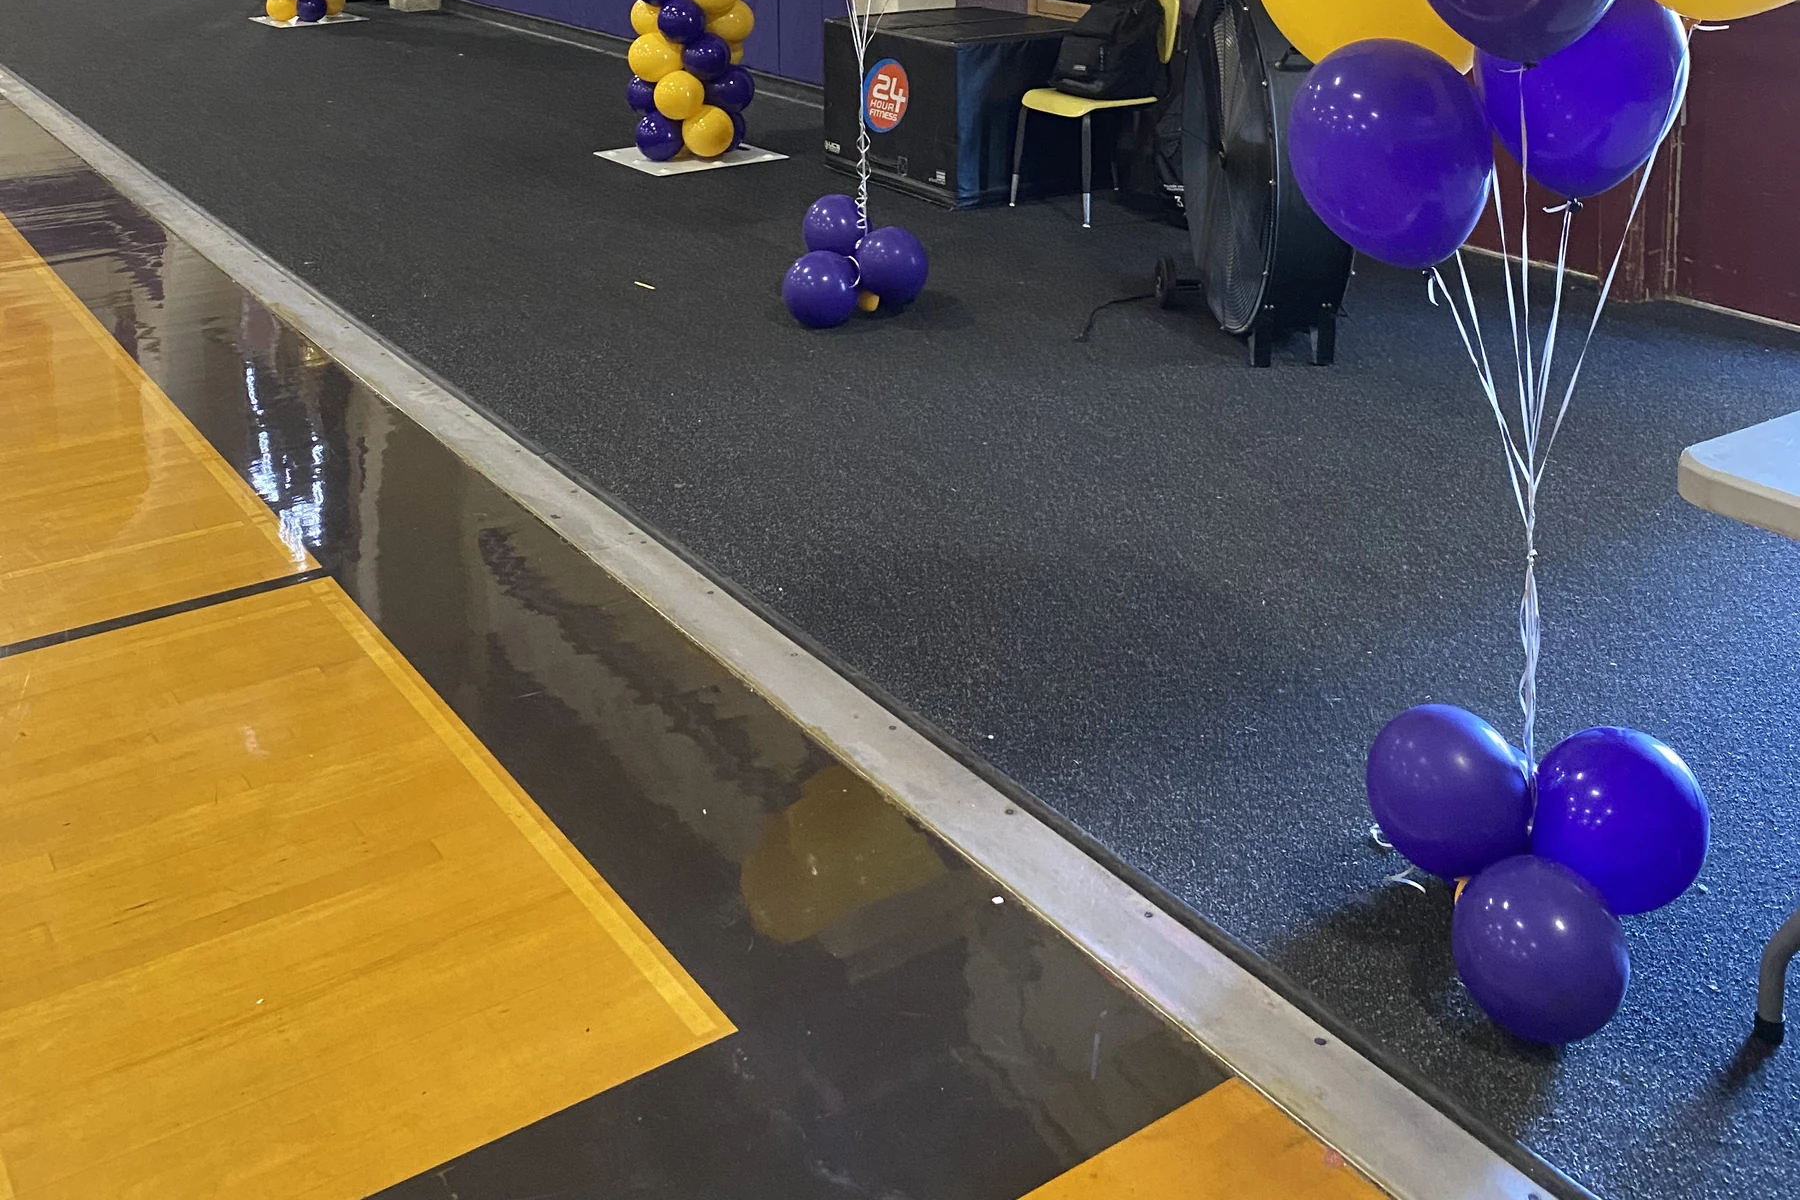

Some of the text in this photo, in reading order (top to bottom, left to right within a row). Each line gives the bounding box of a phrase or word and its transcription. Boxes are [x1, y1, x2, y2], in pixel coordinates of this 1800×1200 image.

[872, 73, 906, 113] 24
[869, 99, 895, 112] HOUR
[869, 108, 898, 122] FITNESS
